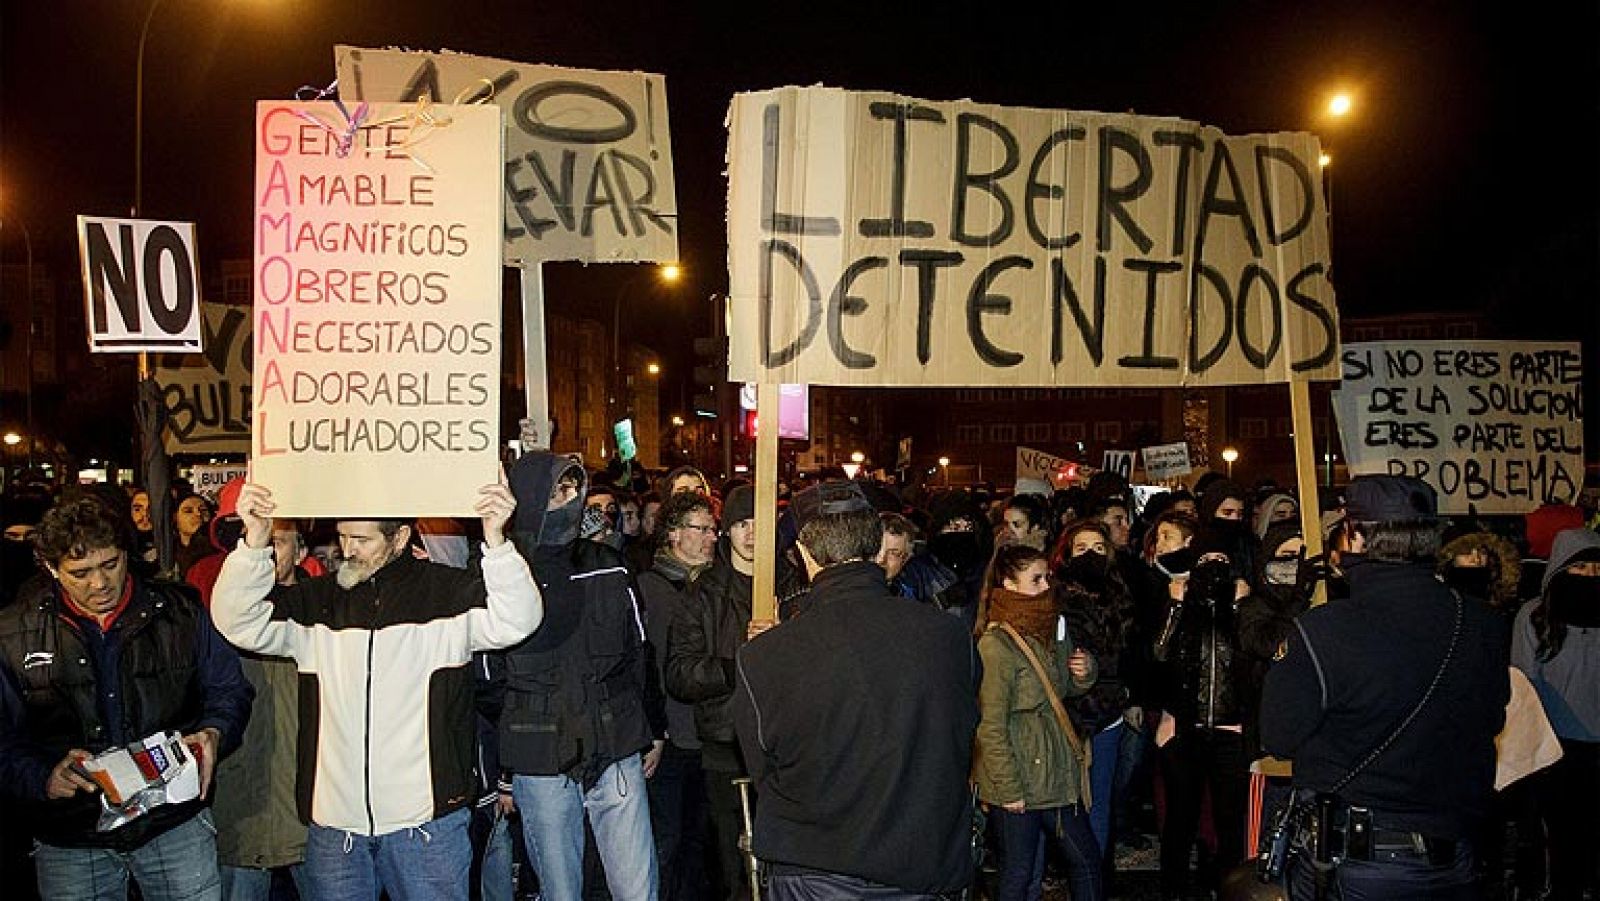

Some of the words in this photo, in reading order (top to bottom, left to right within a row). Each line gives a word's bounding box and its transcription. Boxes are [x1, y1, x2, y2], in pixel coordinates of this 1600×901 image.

[262, 107, 411, 160] GENTE
[262, 159, 434, 207] AMABLE
[505, 148, 674, 241] EVAR
[760, 102, 1315, 258] LIBERTAD
[86, 222, 195, 335] NO
[259, 256, 450, 305] OBREROS
[760, 239, 1337, 374] DETENIDOS
[258, 358, 489, 407] ADORABLES
[1342, 350, 1374, 381] SI
[1385, 349, 1424, 379] NO
[1433, 349, 1501, 378] ERES
[1510, 349, 1583, 385] PARTE
[1368, 387, 1408, 415] DE
[1416, 384, 1451, 415] LA
[1467, 383, 1584, 422] SOLUCION
[258, 411, 491, 456] LUCHADORES
[1364, 420, 1439, 449] ERES
[1453, 422, 1526, 453] PARTE
[1533, 426, 1583, 454] DEL
